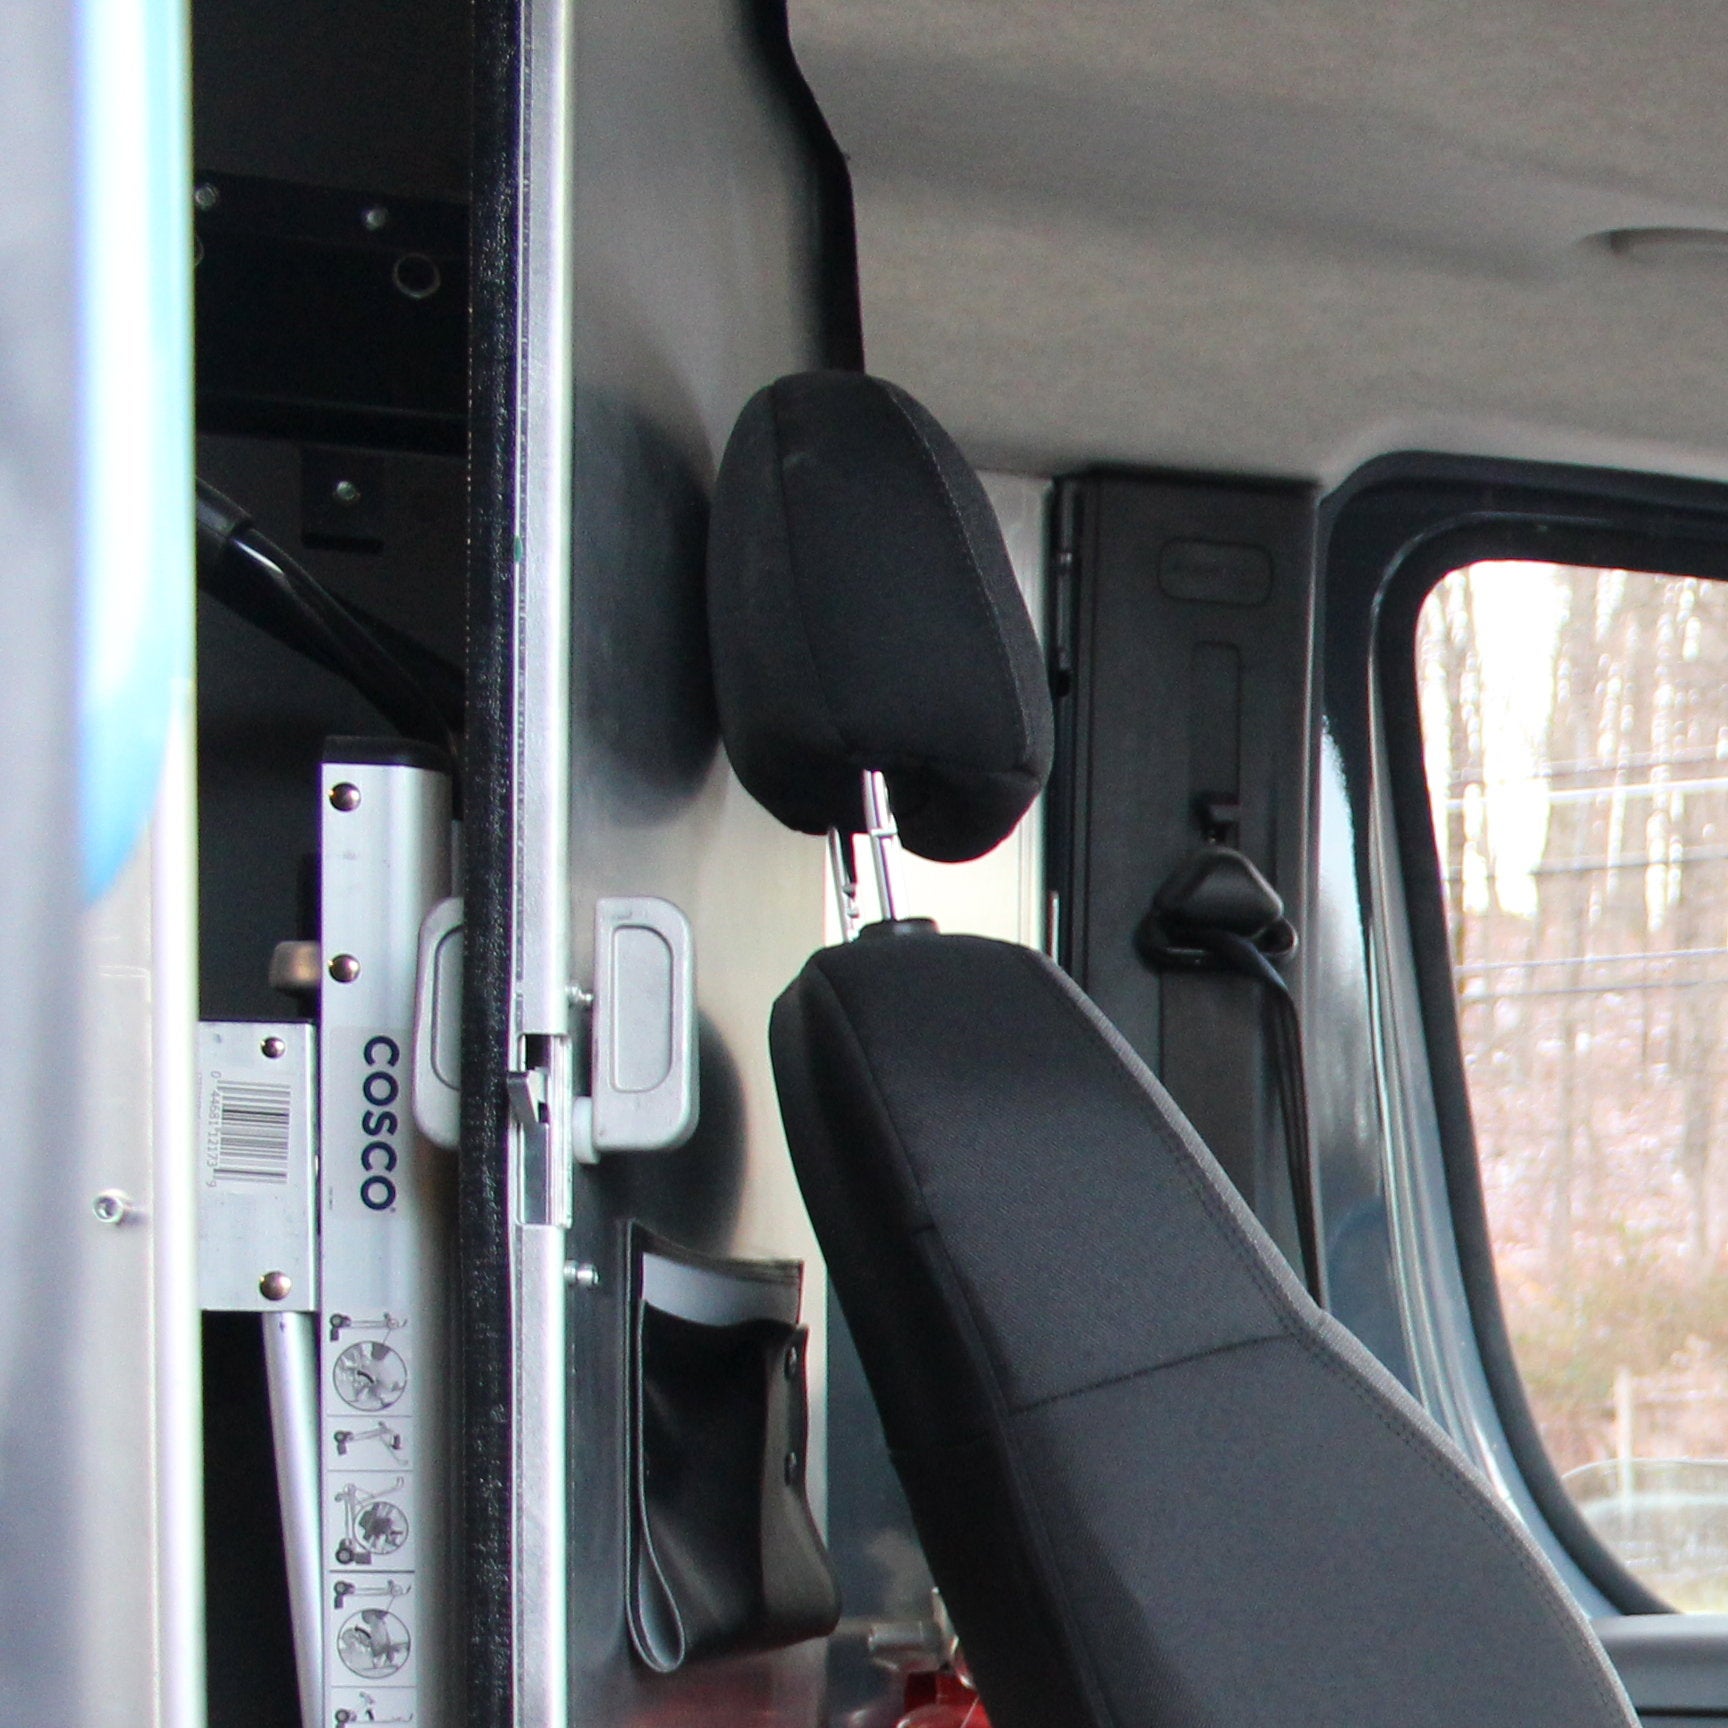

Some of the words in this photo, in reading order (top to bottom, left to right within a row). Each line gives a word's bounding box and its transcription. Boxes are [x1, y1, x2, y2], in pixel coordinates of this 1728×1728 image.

[210, 1070, 222, 1079] 0
[360, 1035, 400, 1211] COSCO
[206, 1131, 220, 1168] 12173
